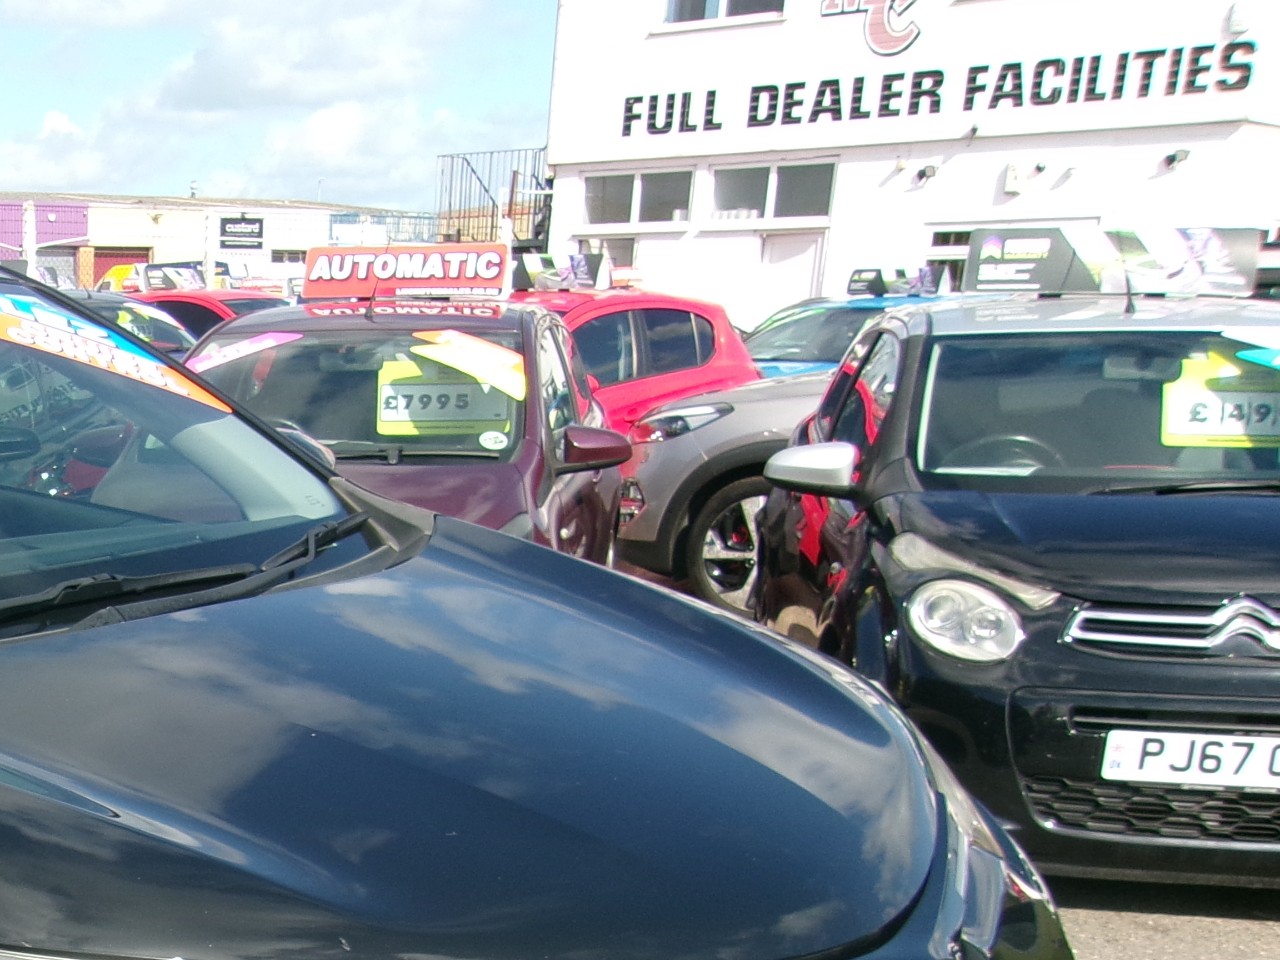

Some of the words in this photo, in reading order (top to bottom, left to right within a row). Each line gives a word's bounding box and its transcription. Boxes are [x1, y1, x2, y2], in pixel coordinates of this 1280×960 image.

[621, 91, 723, 137] FULL
[747, 69, 944, 128] DEALER
[963, 41, 1258, 111] FACILITIES
[308, 252, 501, 281] AUTOMATIC
[383, 393, 470, 411] £7995
[1138, 737, 1256, 776] PJ67
